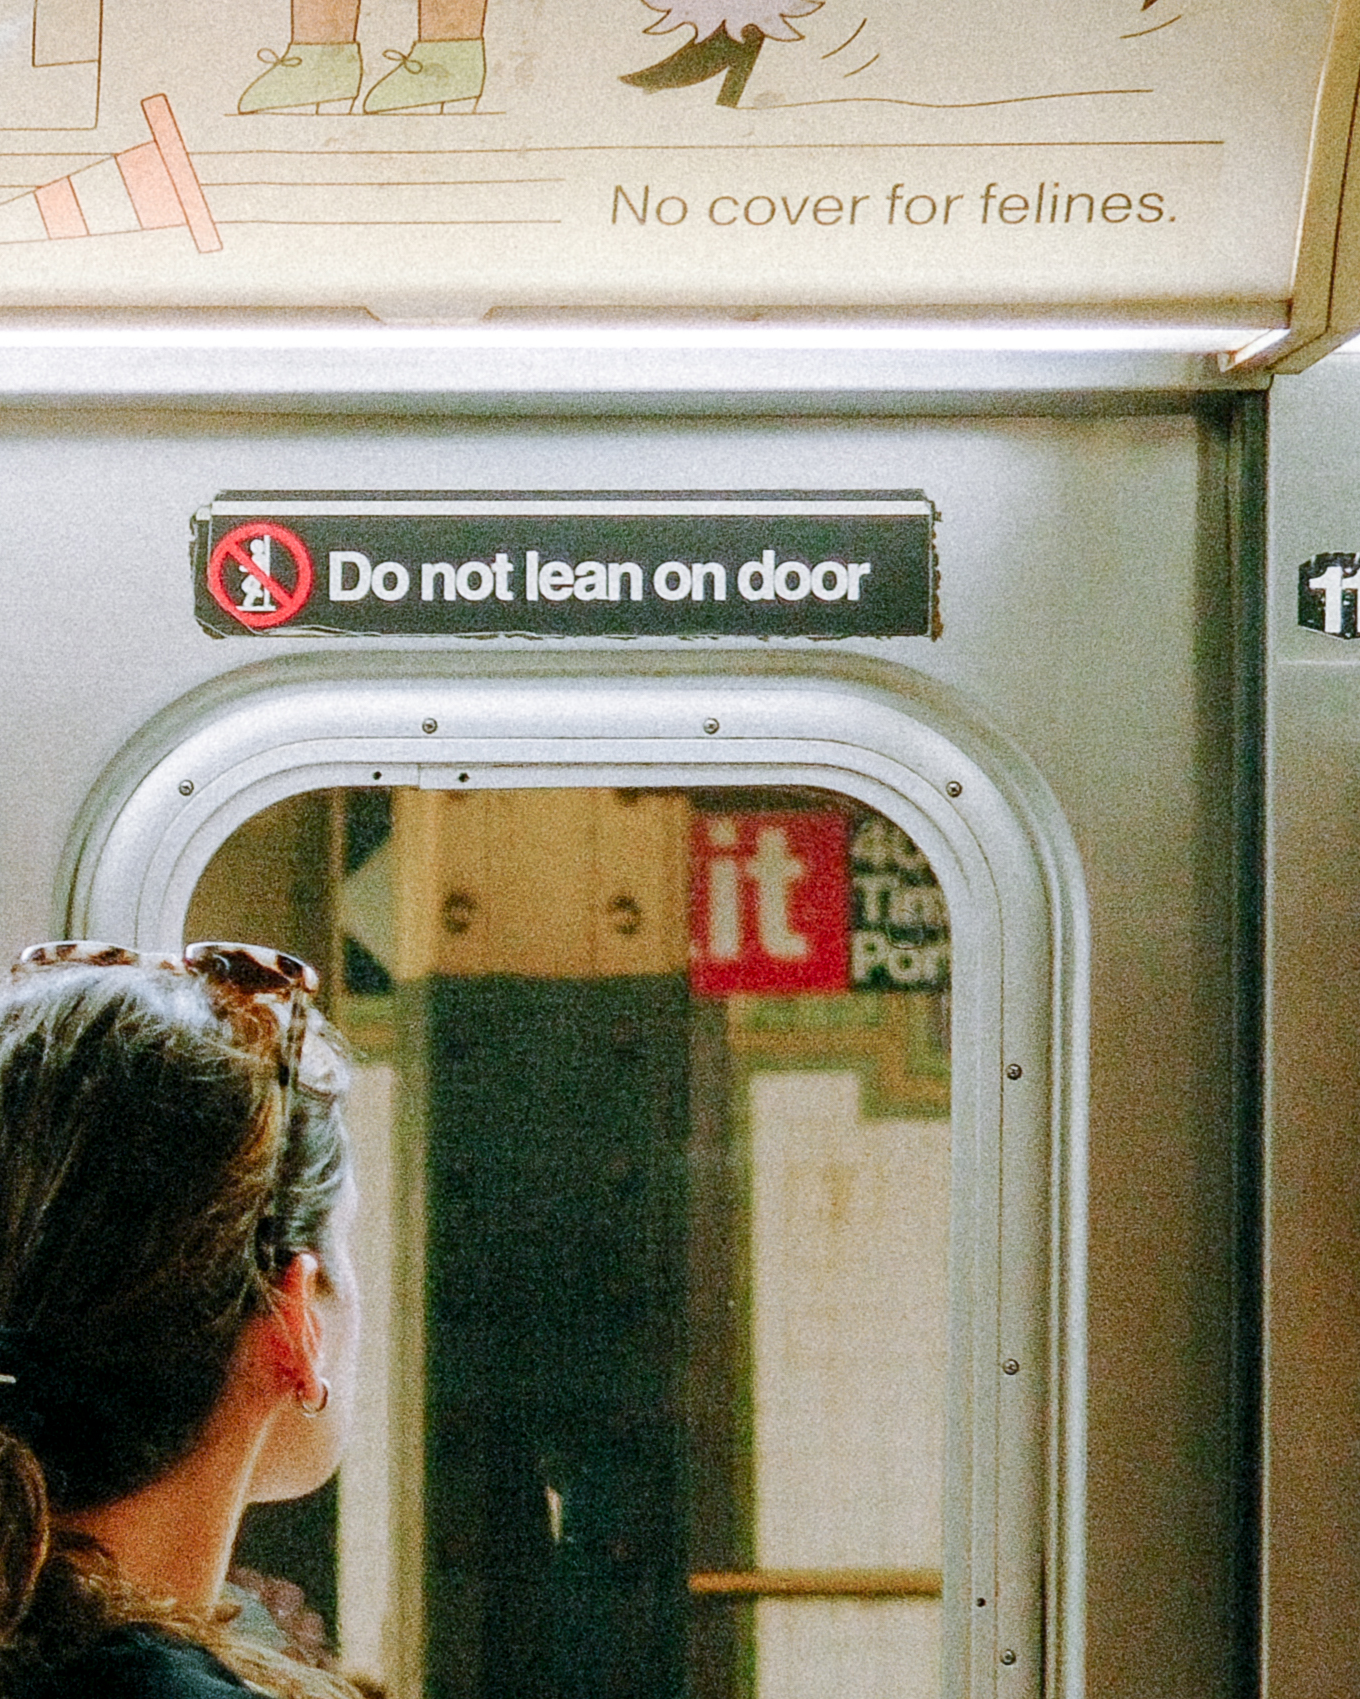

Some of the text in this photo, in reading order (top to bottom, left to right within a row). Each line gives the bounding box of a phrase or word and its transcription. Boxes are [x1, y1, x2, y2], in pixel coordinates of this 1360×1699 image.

[610, 181, 1178, 226] No cover for felines.
[328, 549, 872, 603] Do not lean on door
[708, 817, 808, 960] it
